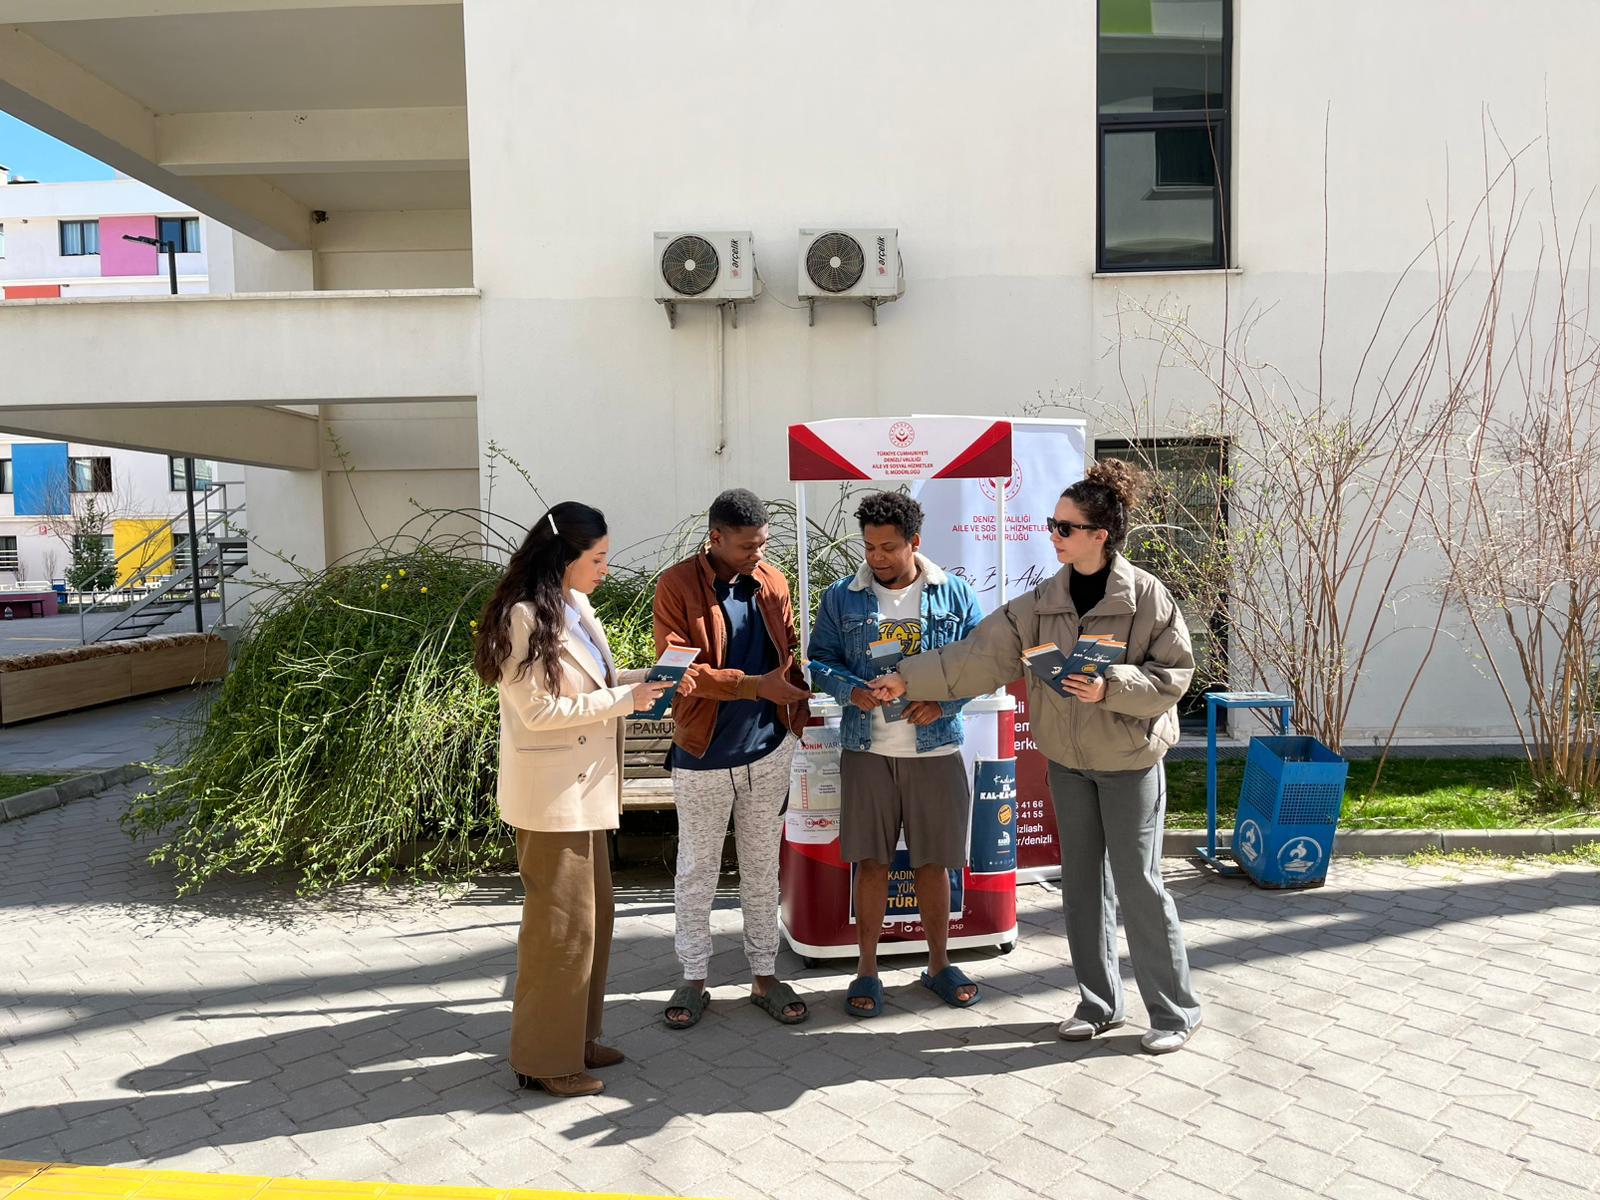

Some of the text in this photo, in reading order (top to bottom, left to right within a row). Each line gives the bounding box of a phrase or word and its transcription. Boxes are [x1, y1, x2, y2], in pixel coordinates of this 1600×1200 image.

[731, 239, 739, 268] arçelik
[877, 236, 886, 266] arçelik
[972, 515, 997, 523] DENİZ
[952, 524, 969, 532] AİLE
[1016, 823, 1043, 834] izliash
